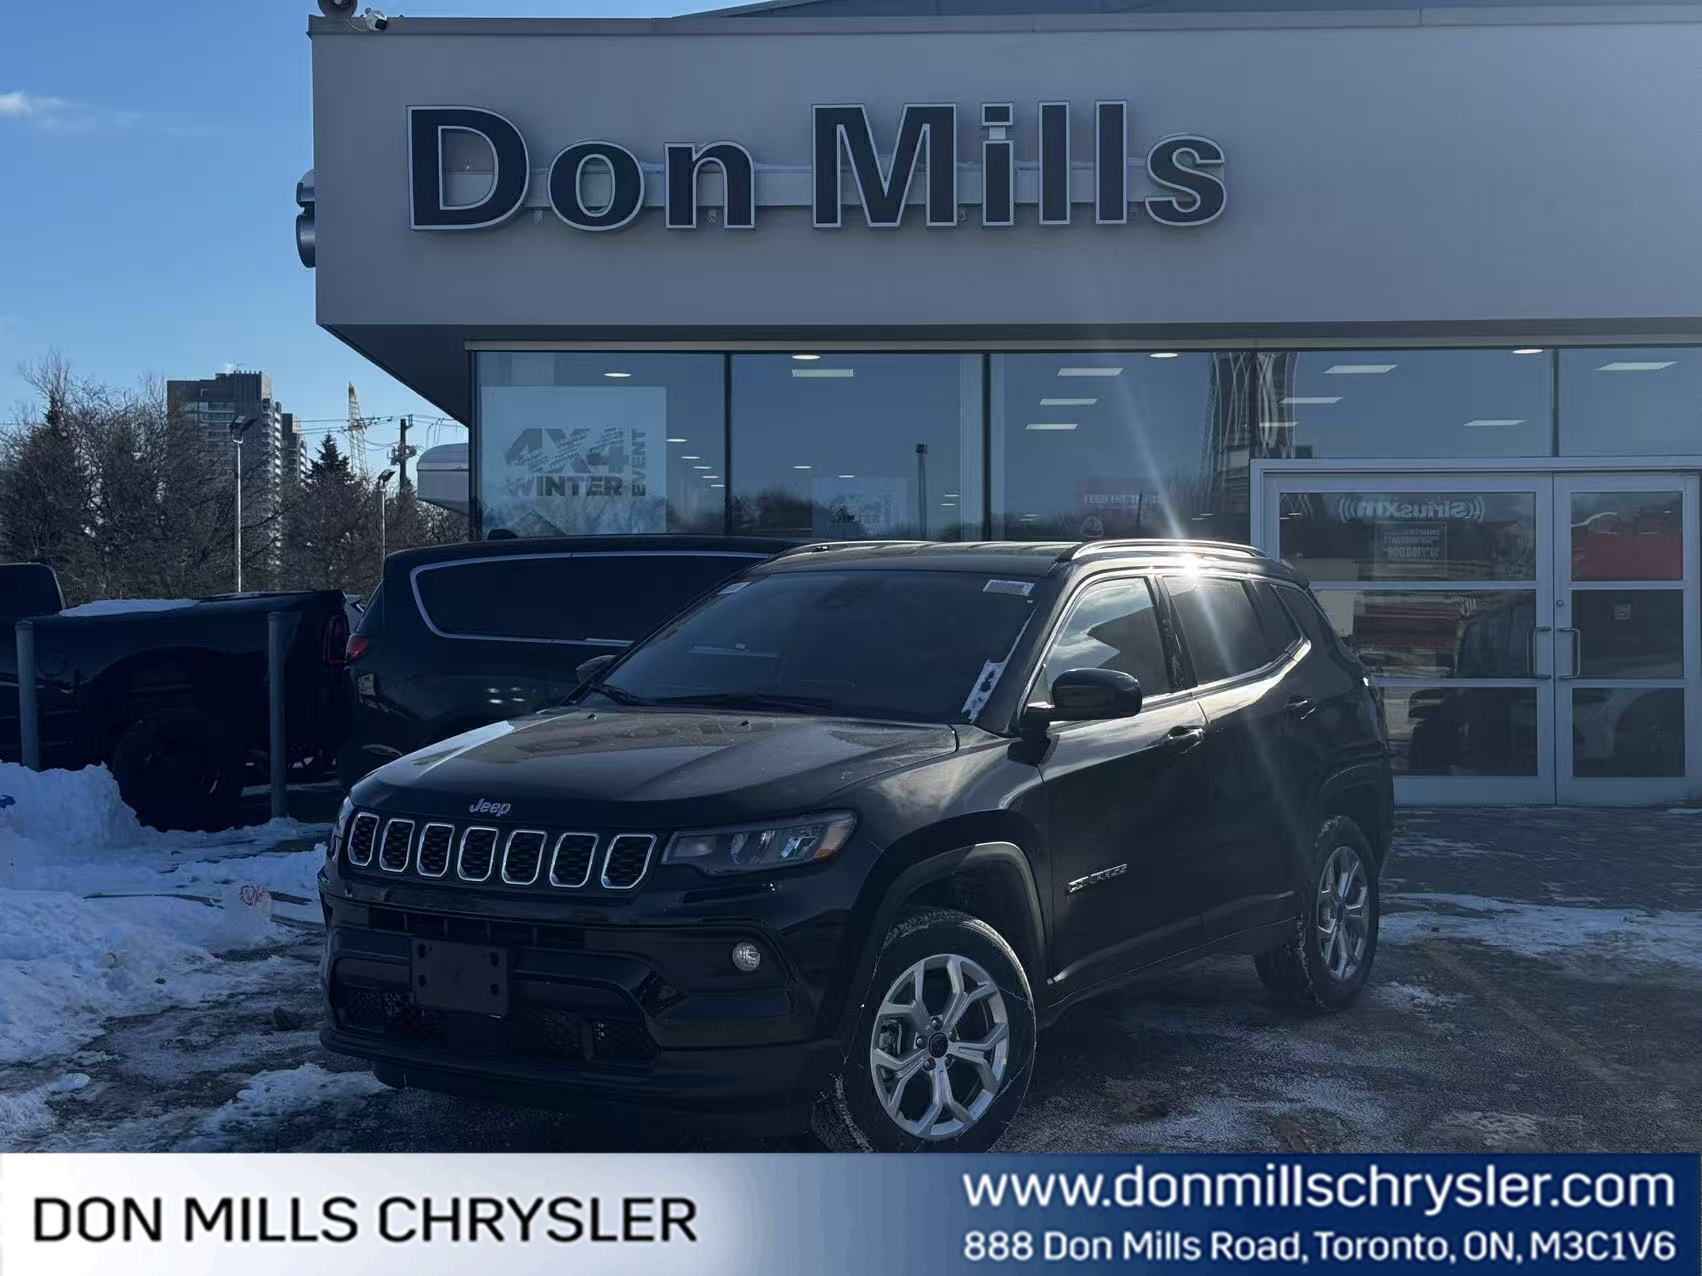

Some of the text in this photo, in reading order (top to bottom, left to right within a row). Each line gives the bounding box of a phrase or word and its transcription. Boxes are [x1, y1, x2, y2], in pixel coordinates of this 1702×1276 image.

[406, 100, 1228, 232] Don Mills
[631, 427, 647, 497] EVENT
[506, 476, 624, 497] WINTER
[469, 798, 511, 816] Jeep
